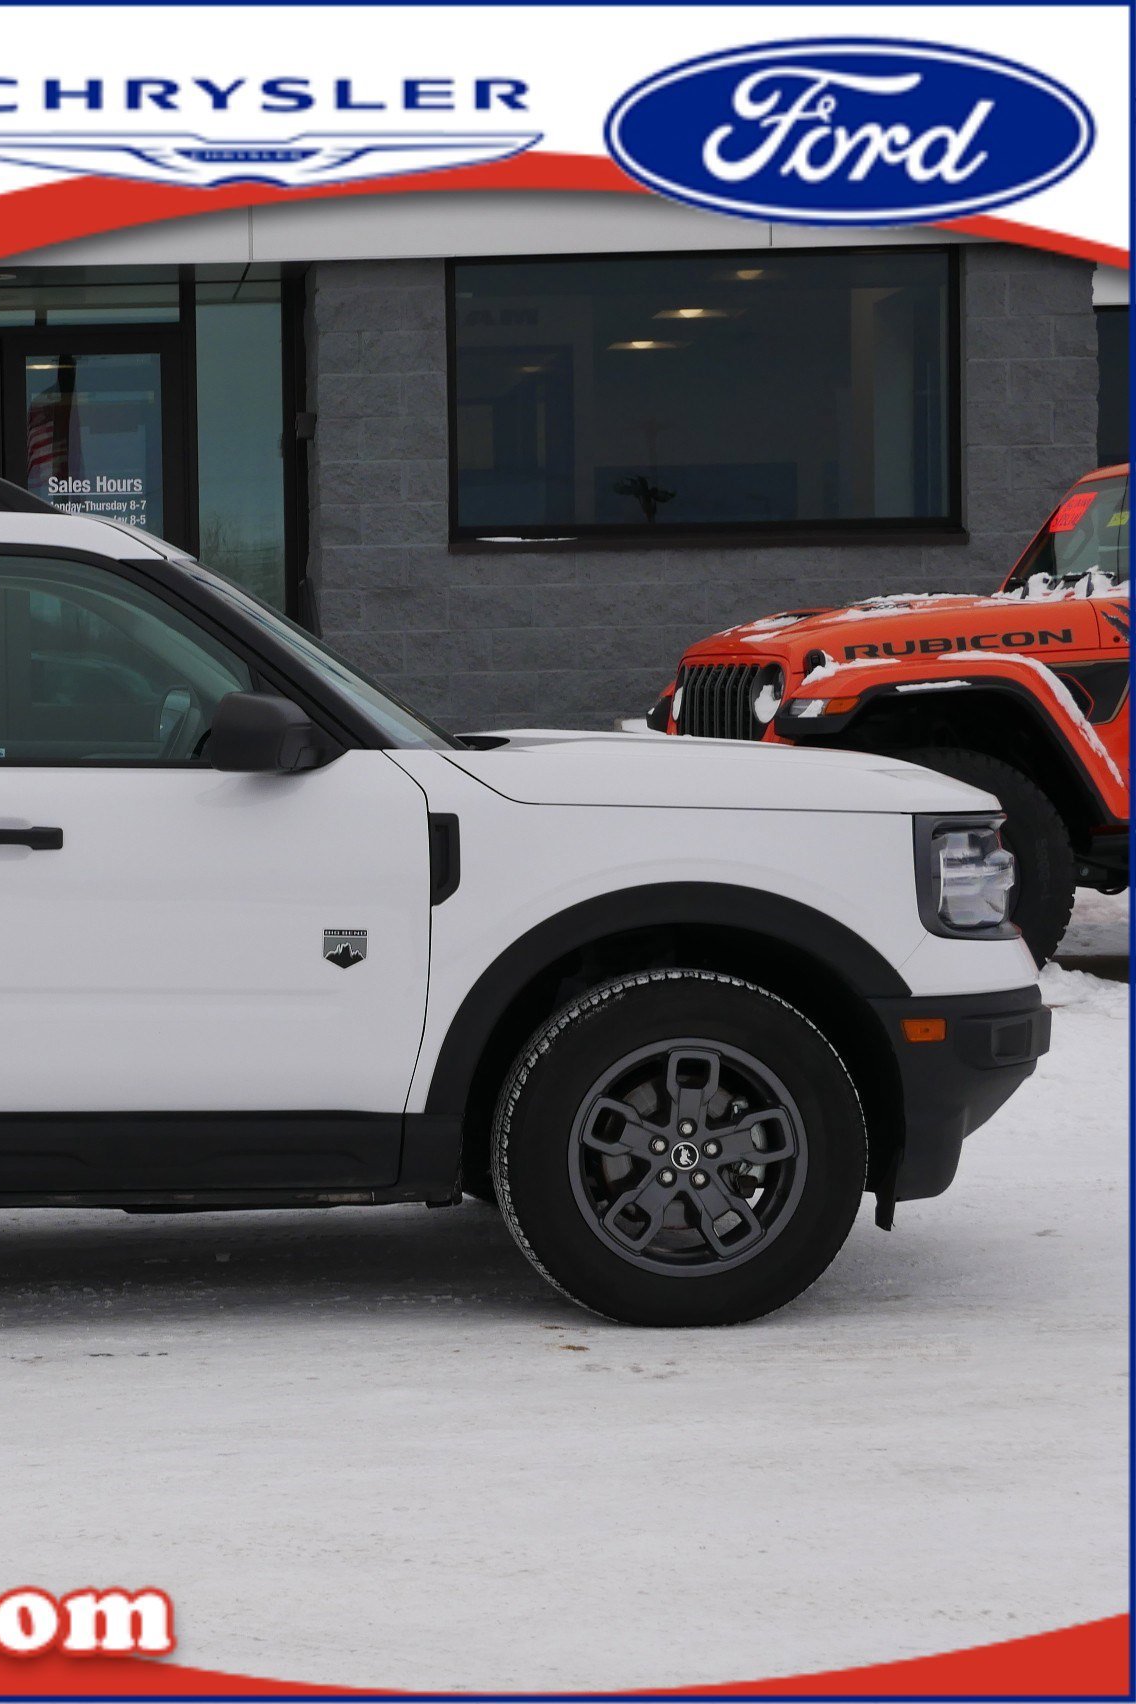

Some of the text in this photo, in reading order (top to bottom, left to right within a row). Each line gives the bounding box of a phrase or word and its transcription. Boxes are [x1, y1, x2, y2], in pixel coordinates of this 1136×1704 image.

[48, 476, 143, 493] Sales Hours
[50, 500, 147, 515] onday-Thursday 8-7
[129, 514, 147, 525] 8-5
[843, 628, 1073, 660] RUBICON
